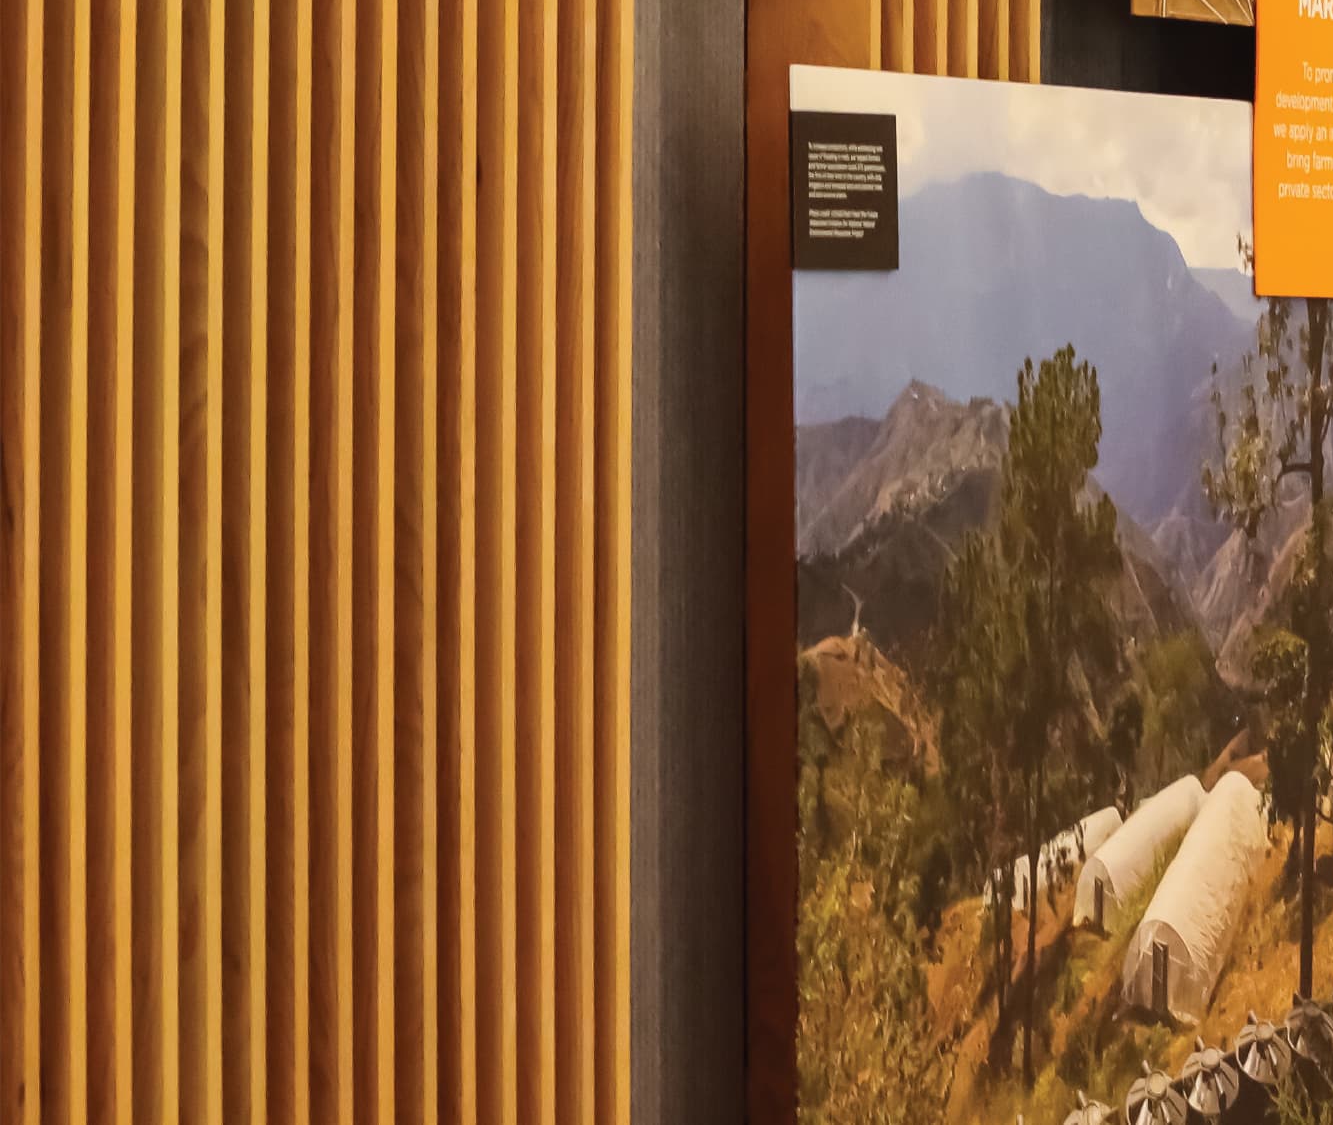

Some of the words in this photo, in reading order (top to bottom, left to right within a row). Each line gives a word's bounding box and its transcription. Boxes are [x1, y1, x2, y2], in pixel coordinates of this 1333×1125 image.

[1303, 61, 1313, 82] To
[1273, 122, 1287, 138] we
[1289, 122, 1313, 143] apply
[1316, 125, 1327, 141] an
[1286, 149, 1311, 174] bring
[1278, 182, 1310, 200] private
